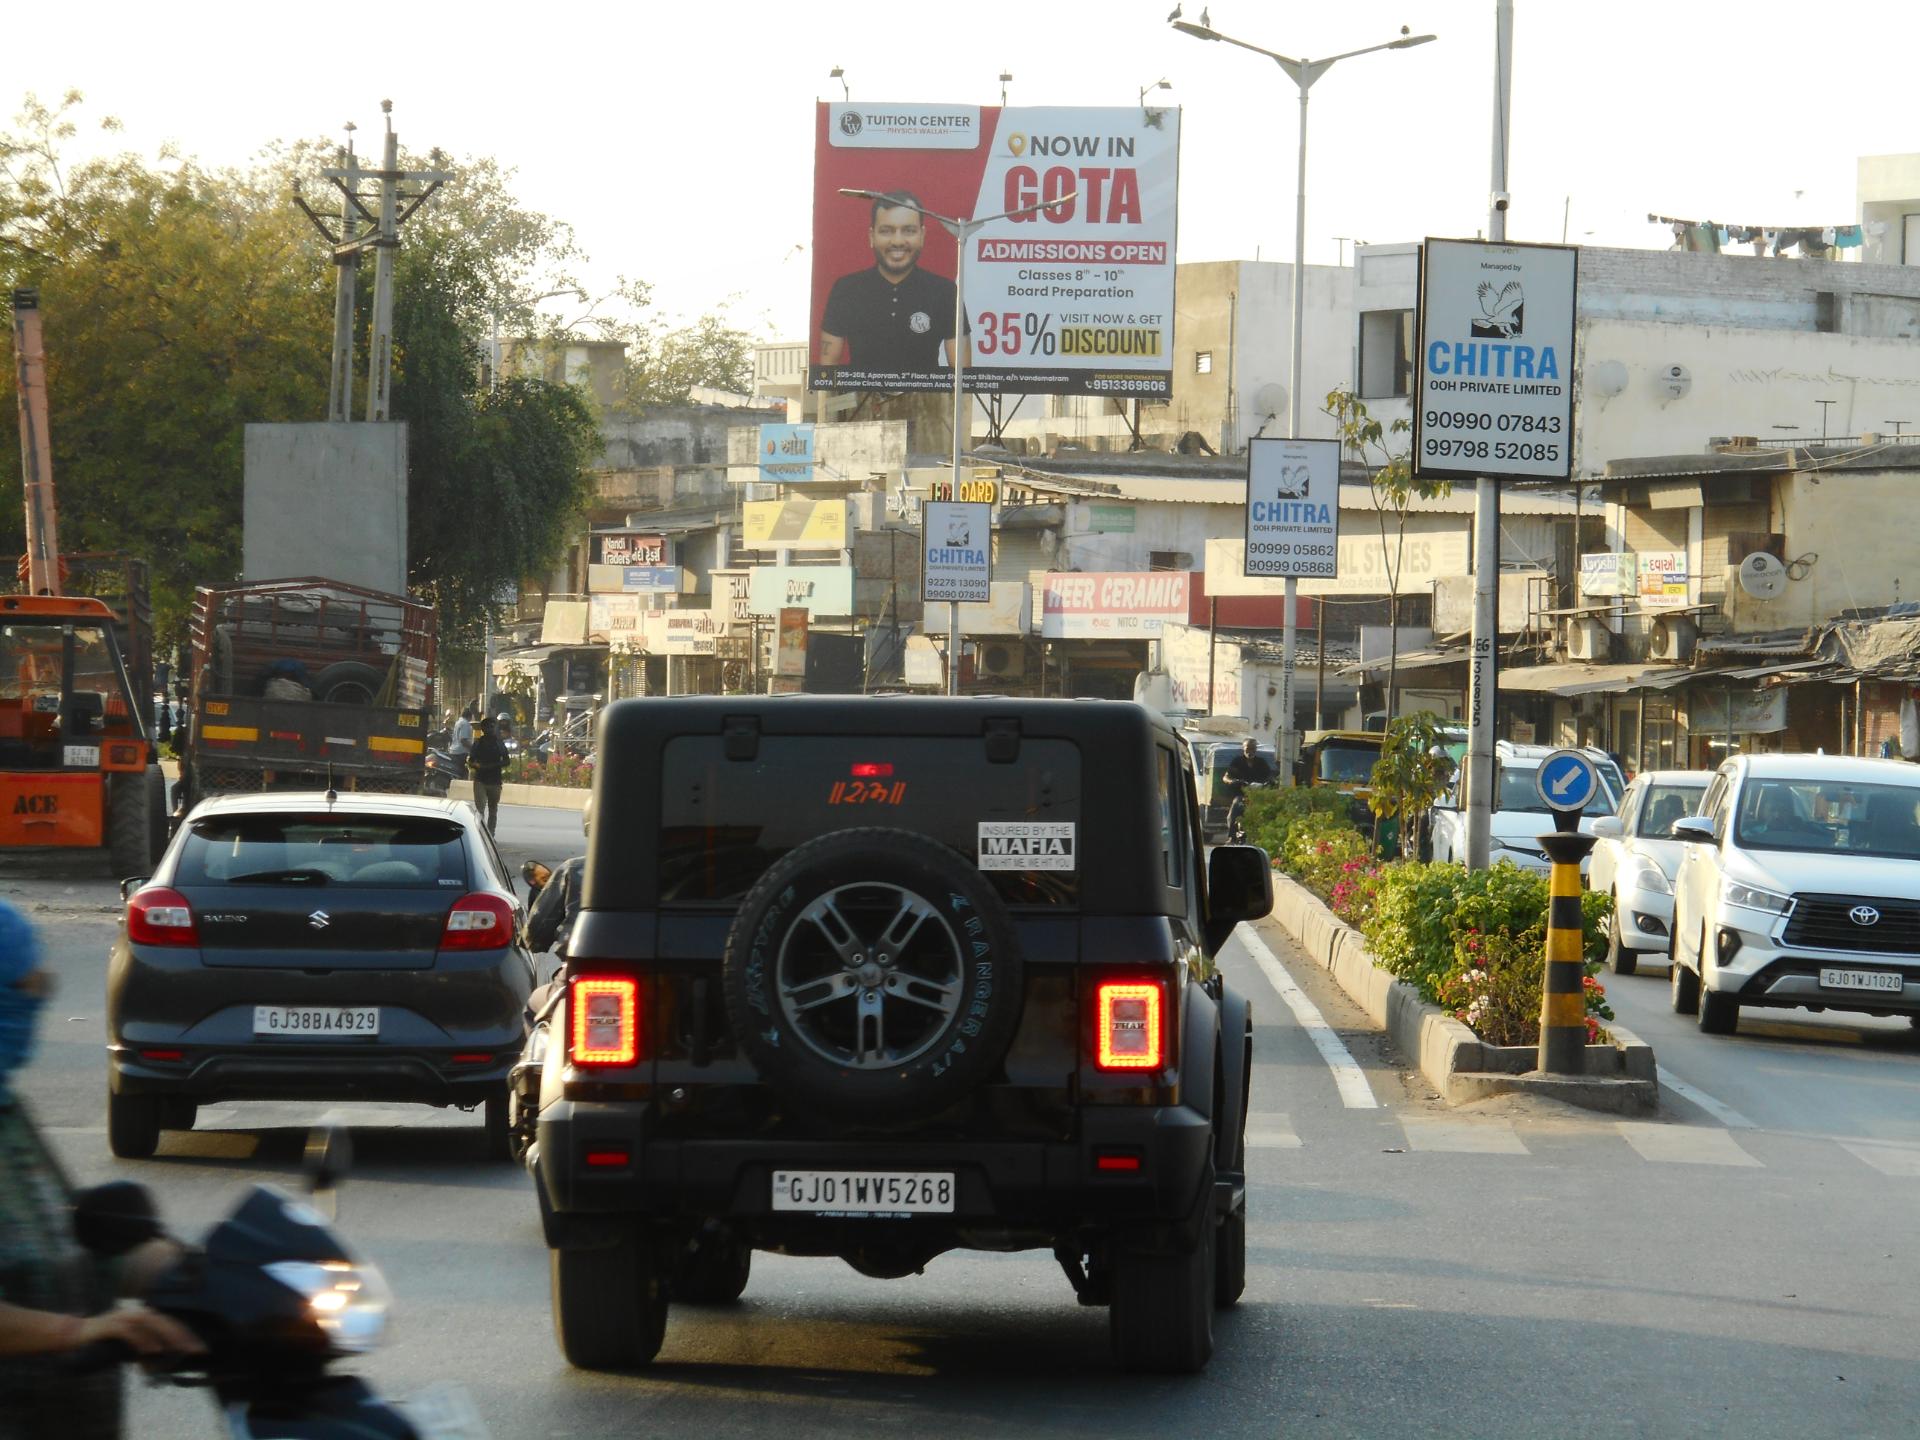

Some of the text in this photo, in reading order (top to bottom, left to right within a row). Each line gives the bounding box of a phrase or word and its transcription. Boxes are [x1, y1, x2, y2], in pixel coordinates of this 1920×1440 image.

[866, 115, 971, 127] TUITION CENTER
[1030, 136, 1135, 158] NOW IN
[1004, 166, 1142, 224] GOTA
[981, 243, 1163, 262] ADMISSIONS OPEN
[1018, 269, 1072, 281] Classes
[1481, 262, 1512, 271] Managed
[1007, 285, 1134, 300] Board Preparation
[1060, 313, 1163, 325] VISIT NOW & GET
[978, 311, 1056, 356] 35%
[1061, 328, 1160, 355] DISCOUNT
[1428, 340, 1559, 380] CHITRA
[1094, 380, 1166, 392] 9513369606
[1430, 380, 1562, 396] OOH PRIVATE LIMITED
[1426, 410, 1561, 433] 90990 07843
[1426, 439, 1559, 462] 99798 52085
[957, 480, 995, 503] OARD
[1252, 502, 1331, 524] CHITRA
[1271, 525, 1302, 533] PRIVATE
[1303, 526, 1333, 534] LIMITED
[605, 536, 626, 550] Nandi
[1249, 543, 1334, 556] 90999 05862
[928, 548, 985, 565] CHITRA
[1363, 541, 1432, 574] STONES
[1248, 560, 1290, 572] 90999
[1292, 561, 1334, 573] 05868
[1048, 576, 1184, 609] HEER CERAMIC
[13, 795, 57, 814] ACE
[983, 826, 1071, 836] INSURED BY THE
[987, 838, 1066, 855] MAFIA
[269, 1012, 377, 1031] GJ38BA4929
[790, 1176, 951, 1205] GJ01WV5268
